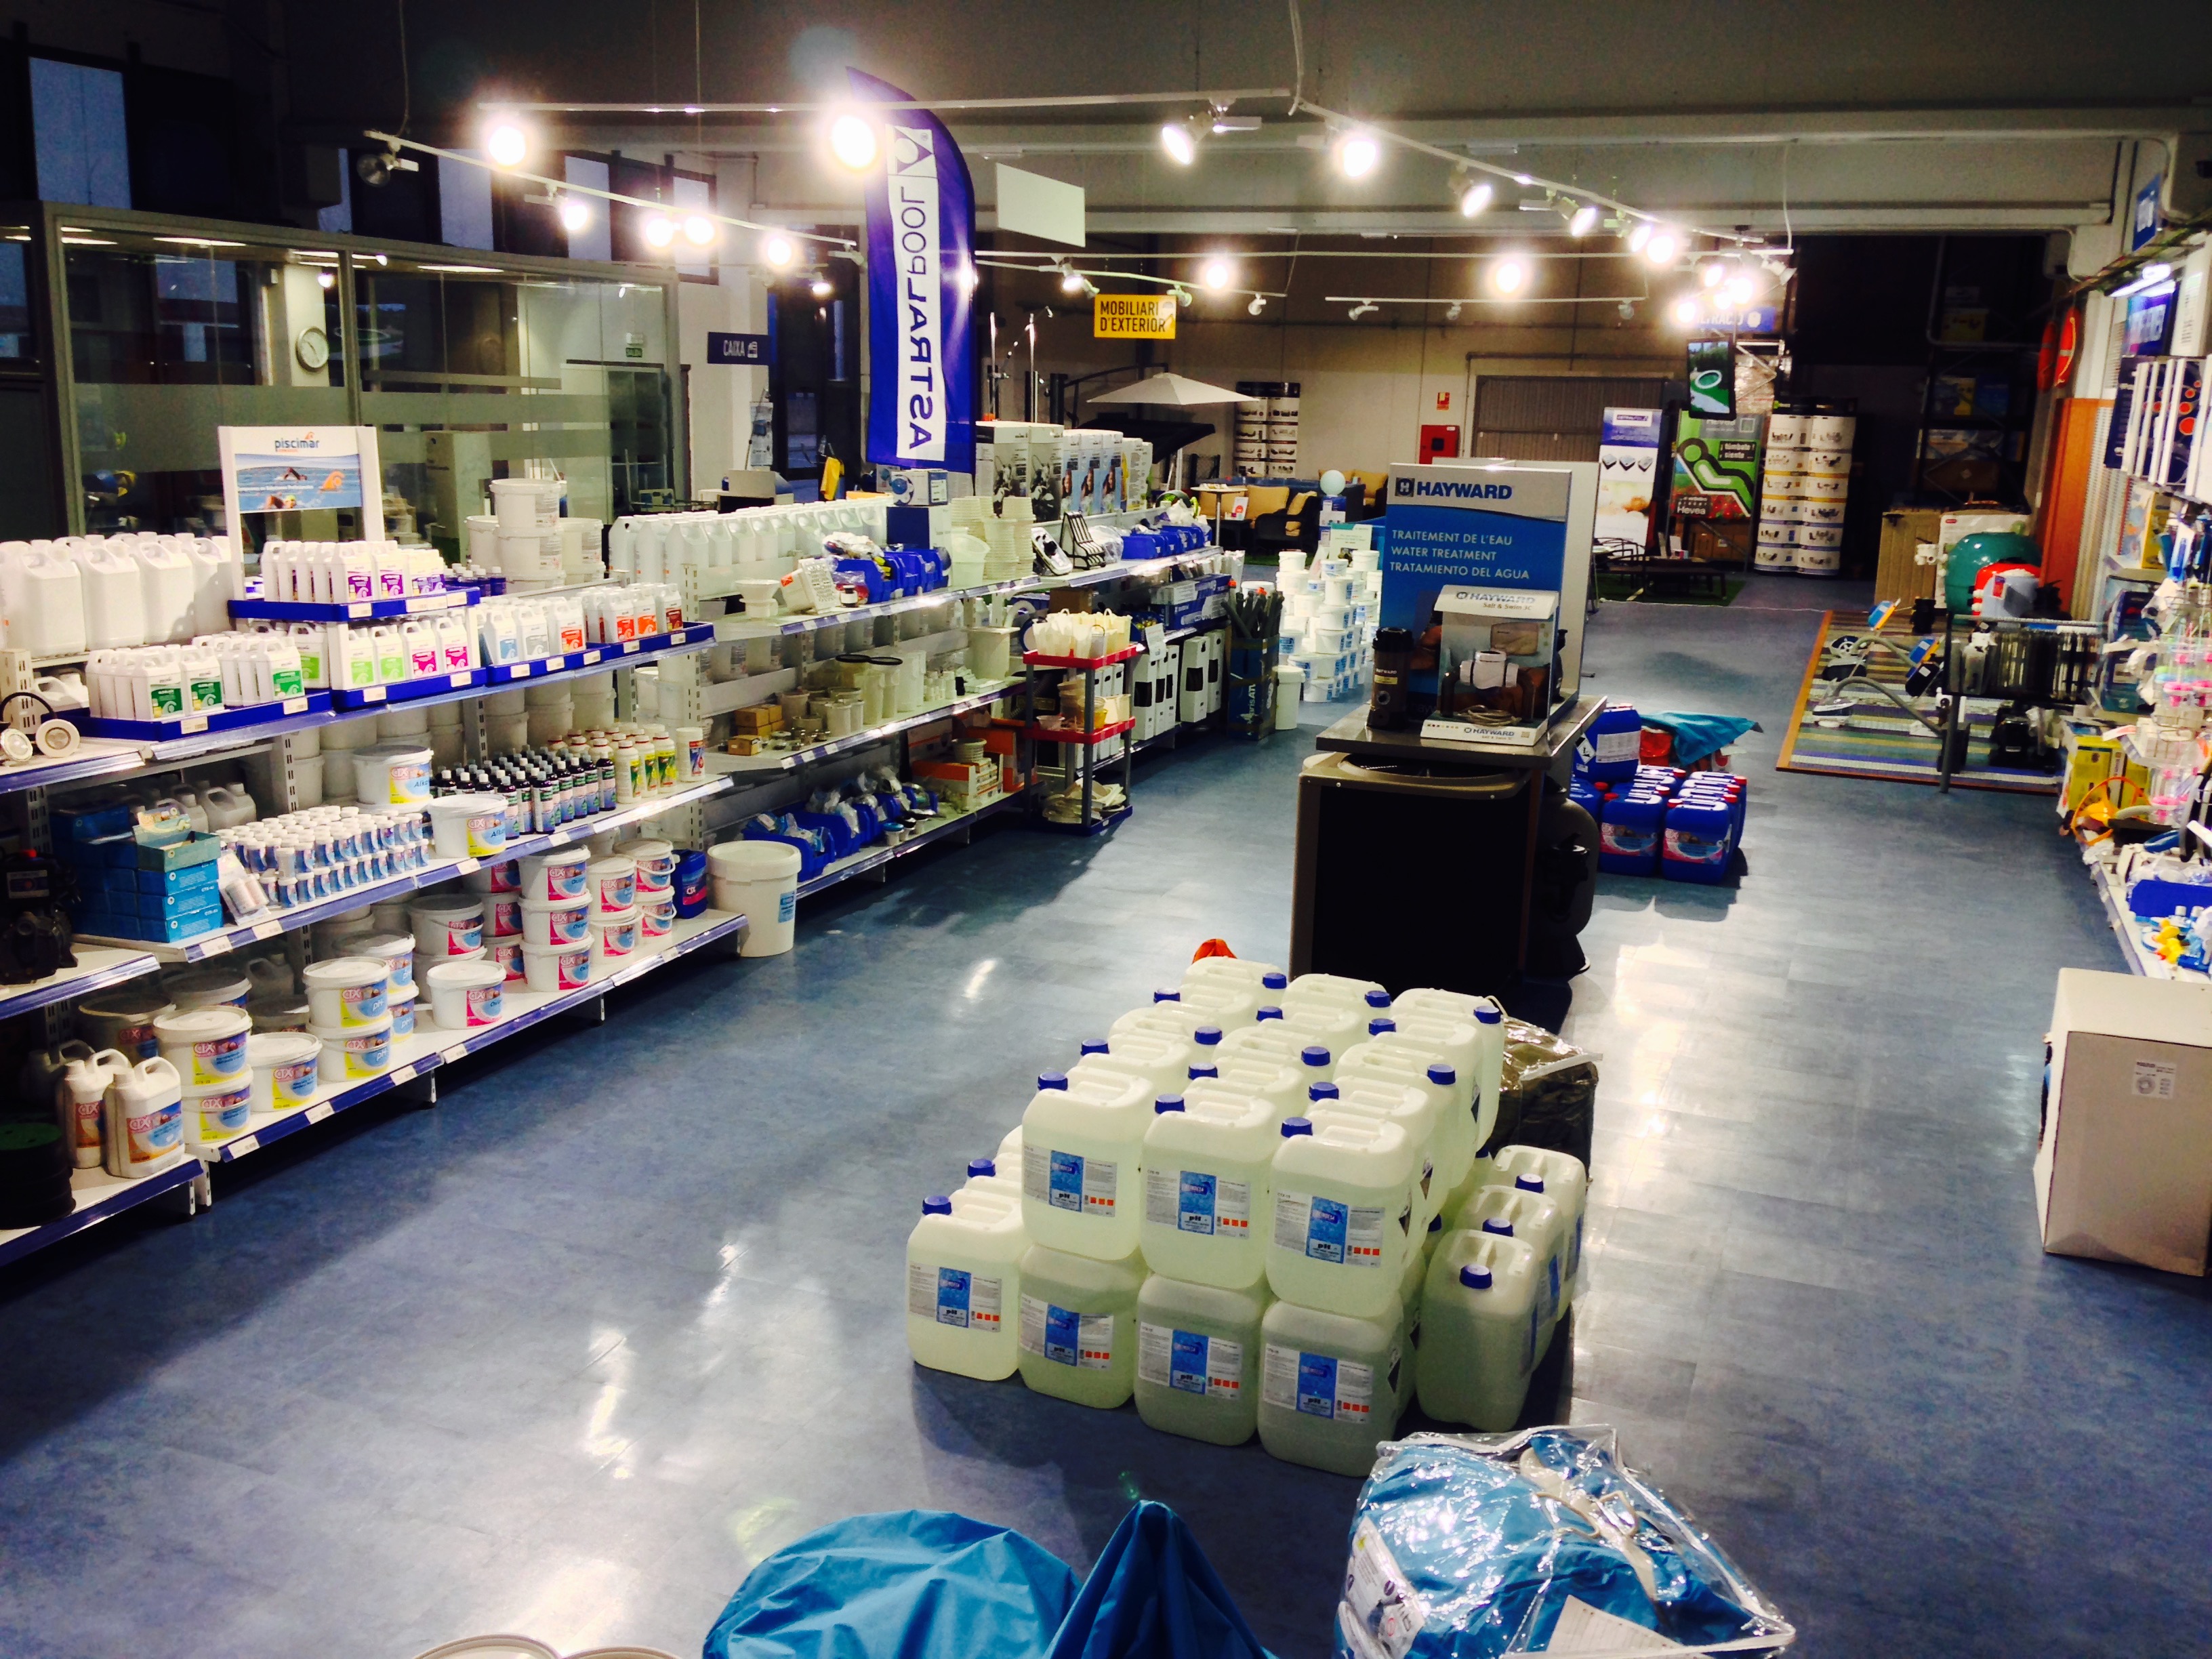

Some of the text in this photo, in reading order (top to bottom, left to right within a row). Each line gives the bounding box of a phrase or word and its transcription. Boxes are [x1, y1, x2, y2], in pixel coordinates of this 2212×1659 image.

[1100, 301, 1158, 316] MOBILIARI
[1100, 317, 1166, 332] D'EXTERIOR
[723, 340, 745, 356] CAIXA
[274, 438, 320, 452] piscimar
[1417, 482, 1513, 499] HAYWARD
[1392, 529, 1512, 546] TRAITEMENT DE L'EAU
[1391, 546, 1496, 561] WATER TREATMENT
[1390, 562, 1530, 579] TRATAMIENTO DEL AGUA
[1470, 592, 1535, 604] HAYWARD
[1473, 729, 1515, 737] HAYWARD
[549, 868, 566, 878] CTX
[552, 913, 568, 923] CTX
[342, 989, 362, 1000] CTX
[468, 990, 486, 1001] CTX
[194, 1043, 216, 1054] CTX
[347, 1039, 366, 1050] CTX
[274, 1068, 293, 1080] CTX
[78, 1103, 100, 1116] CTX
[201, 1098, 223, 1109] CTX
[129, 1115, 151, 1131] CTX
